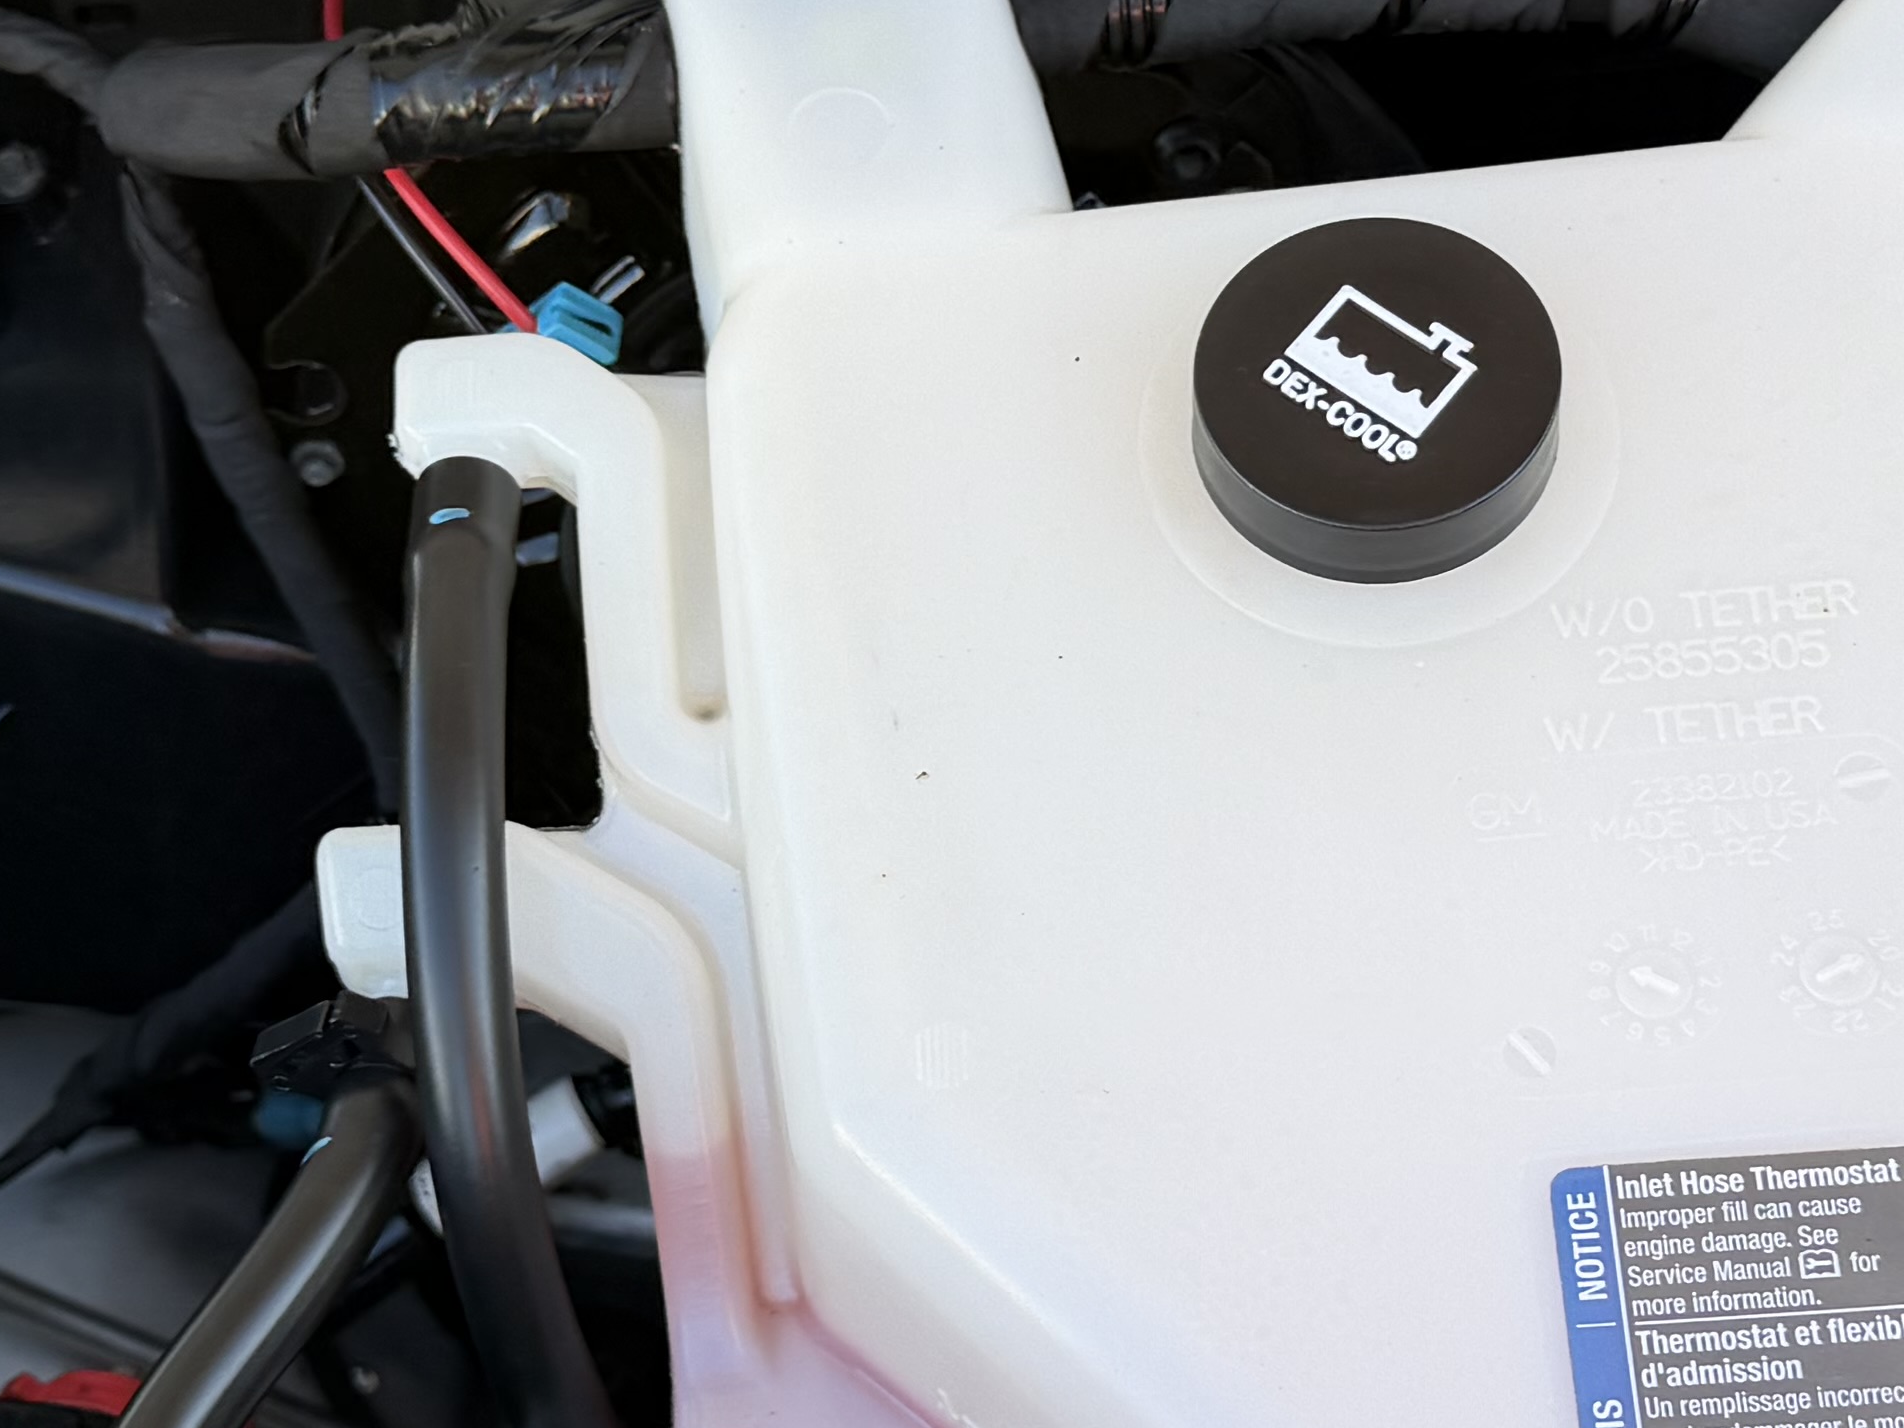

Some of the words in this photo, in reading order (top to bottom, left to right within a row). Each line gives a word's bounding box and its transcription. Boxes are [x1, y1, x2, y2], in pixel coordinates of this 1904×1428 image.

[1549, 595, 1655, 640] W/O
[1678, 579, 1860, 630] TETHER
[1596, 628, 1832, 685] 25855305
[1543, 711, 1616, 753] W/
[1643, 694, 1827, 745] TETHER
[1589, 807, 1693, 844] MADE
[1712, 804, 1749, 835] IN
[1764, 800, 1838, 830] USA
[1616, 1173, 1675, 1200] Inlet
[1681, 1169, 1744, 1197] Hose
[1749, 1158, 1902, 1192] Thermostat
[1620, 1203, 1716, 1232] Improper
[1721, 1200, 1749, 1223] fill
[1754, 1201, 1793, 1221] can
[1798, 1195, 1862, 1217] cause
[1566, 1191, 1609, 1302] NOTICE
[1624, 1233, 1696, 1261] engine
[1701, 1229, 1793, 1255] damage.
[1797, 1226, 1839, 1247] See
[1627, 1262, 1708, 1287] Service
[1713, 1257, 1792, 1283] Manual
[1849, 1252, 1880, 1273] for
[1632, 1296, 1687, 1316] more
[1692, 1287, 1823, 1312] information.
[1635, 1322, 1788, 1355] Thermostat
[1796, 1320, 1822, 1346] et
[1640, 1358, 1804, 1389] d'admission
[1644, 1396, 1675, 1420] Un
[1679, 1388, 1812, 1418] remplissage
